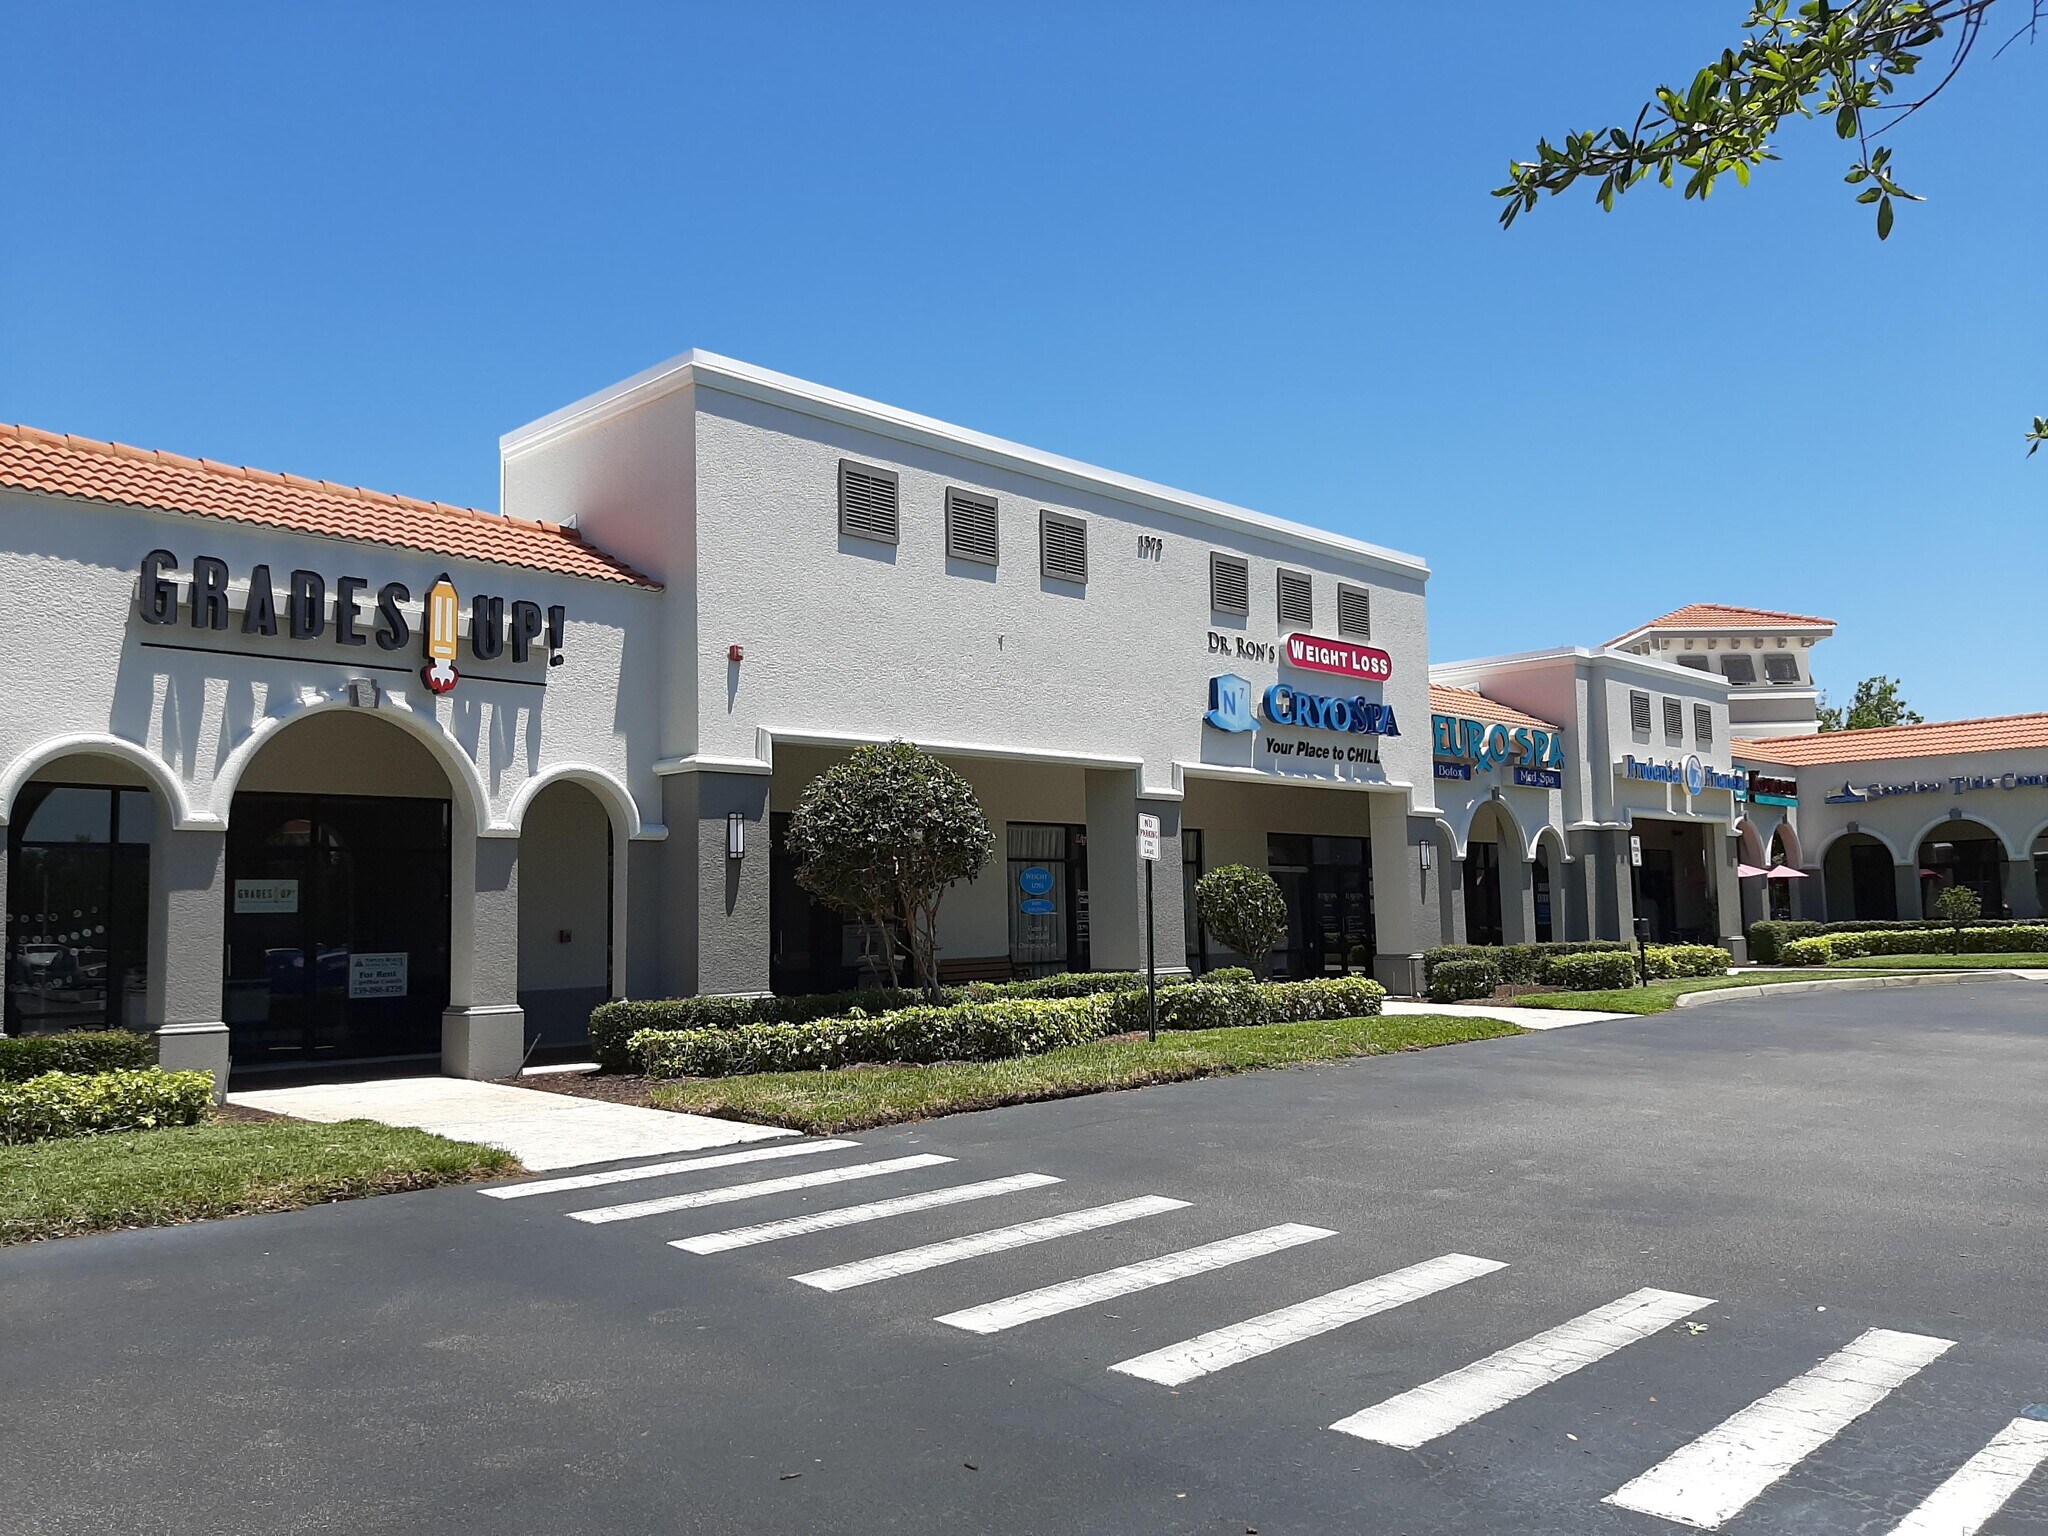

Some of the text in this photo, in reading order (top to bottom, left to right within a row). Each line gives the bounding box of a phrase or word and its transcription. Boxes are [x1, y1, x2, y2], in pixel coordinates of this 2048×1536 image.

[1137, 535, 1163, 551] 1575
[140, 549, 565, 667] GRADES UP!
[1207, 631, 1276, 660] DR. RON'S
[1290, 638, 1388, 675] WEIGHT LOSS
[1266, 737, 1381, 765] Your Place to CHILL
[1432, 714, 1565, 774] EURO SPA
[1438, 764, 1463, 777] Botox
[1627, 756, 1683, 784] Prudential
[1144, 818, 1153, 828] NO
[237, 888, 273, 899] GRADES
[359, 970, 397, 979] For Rent
